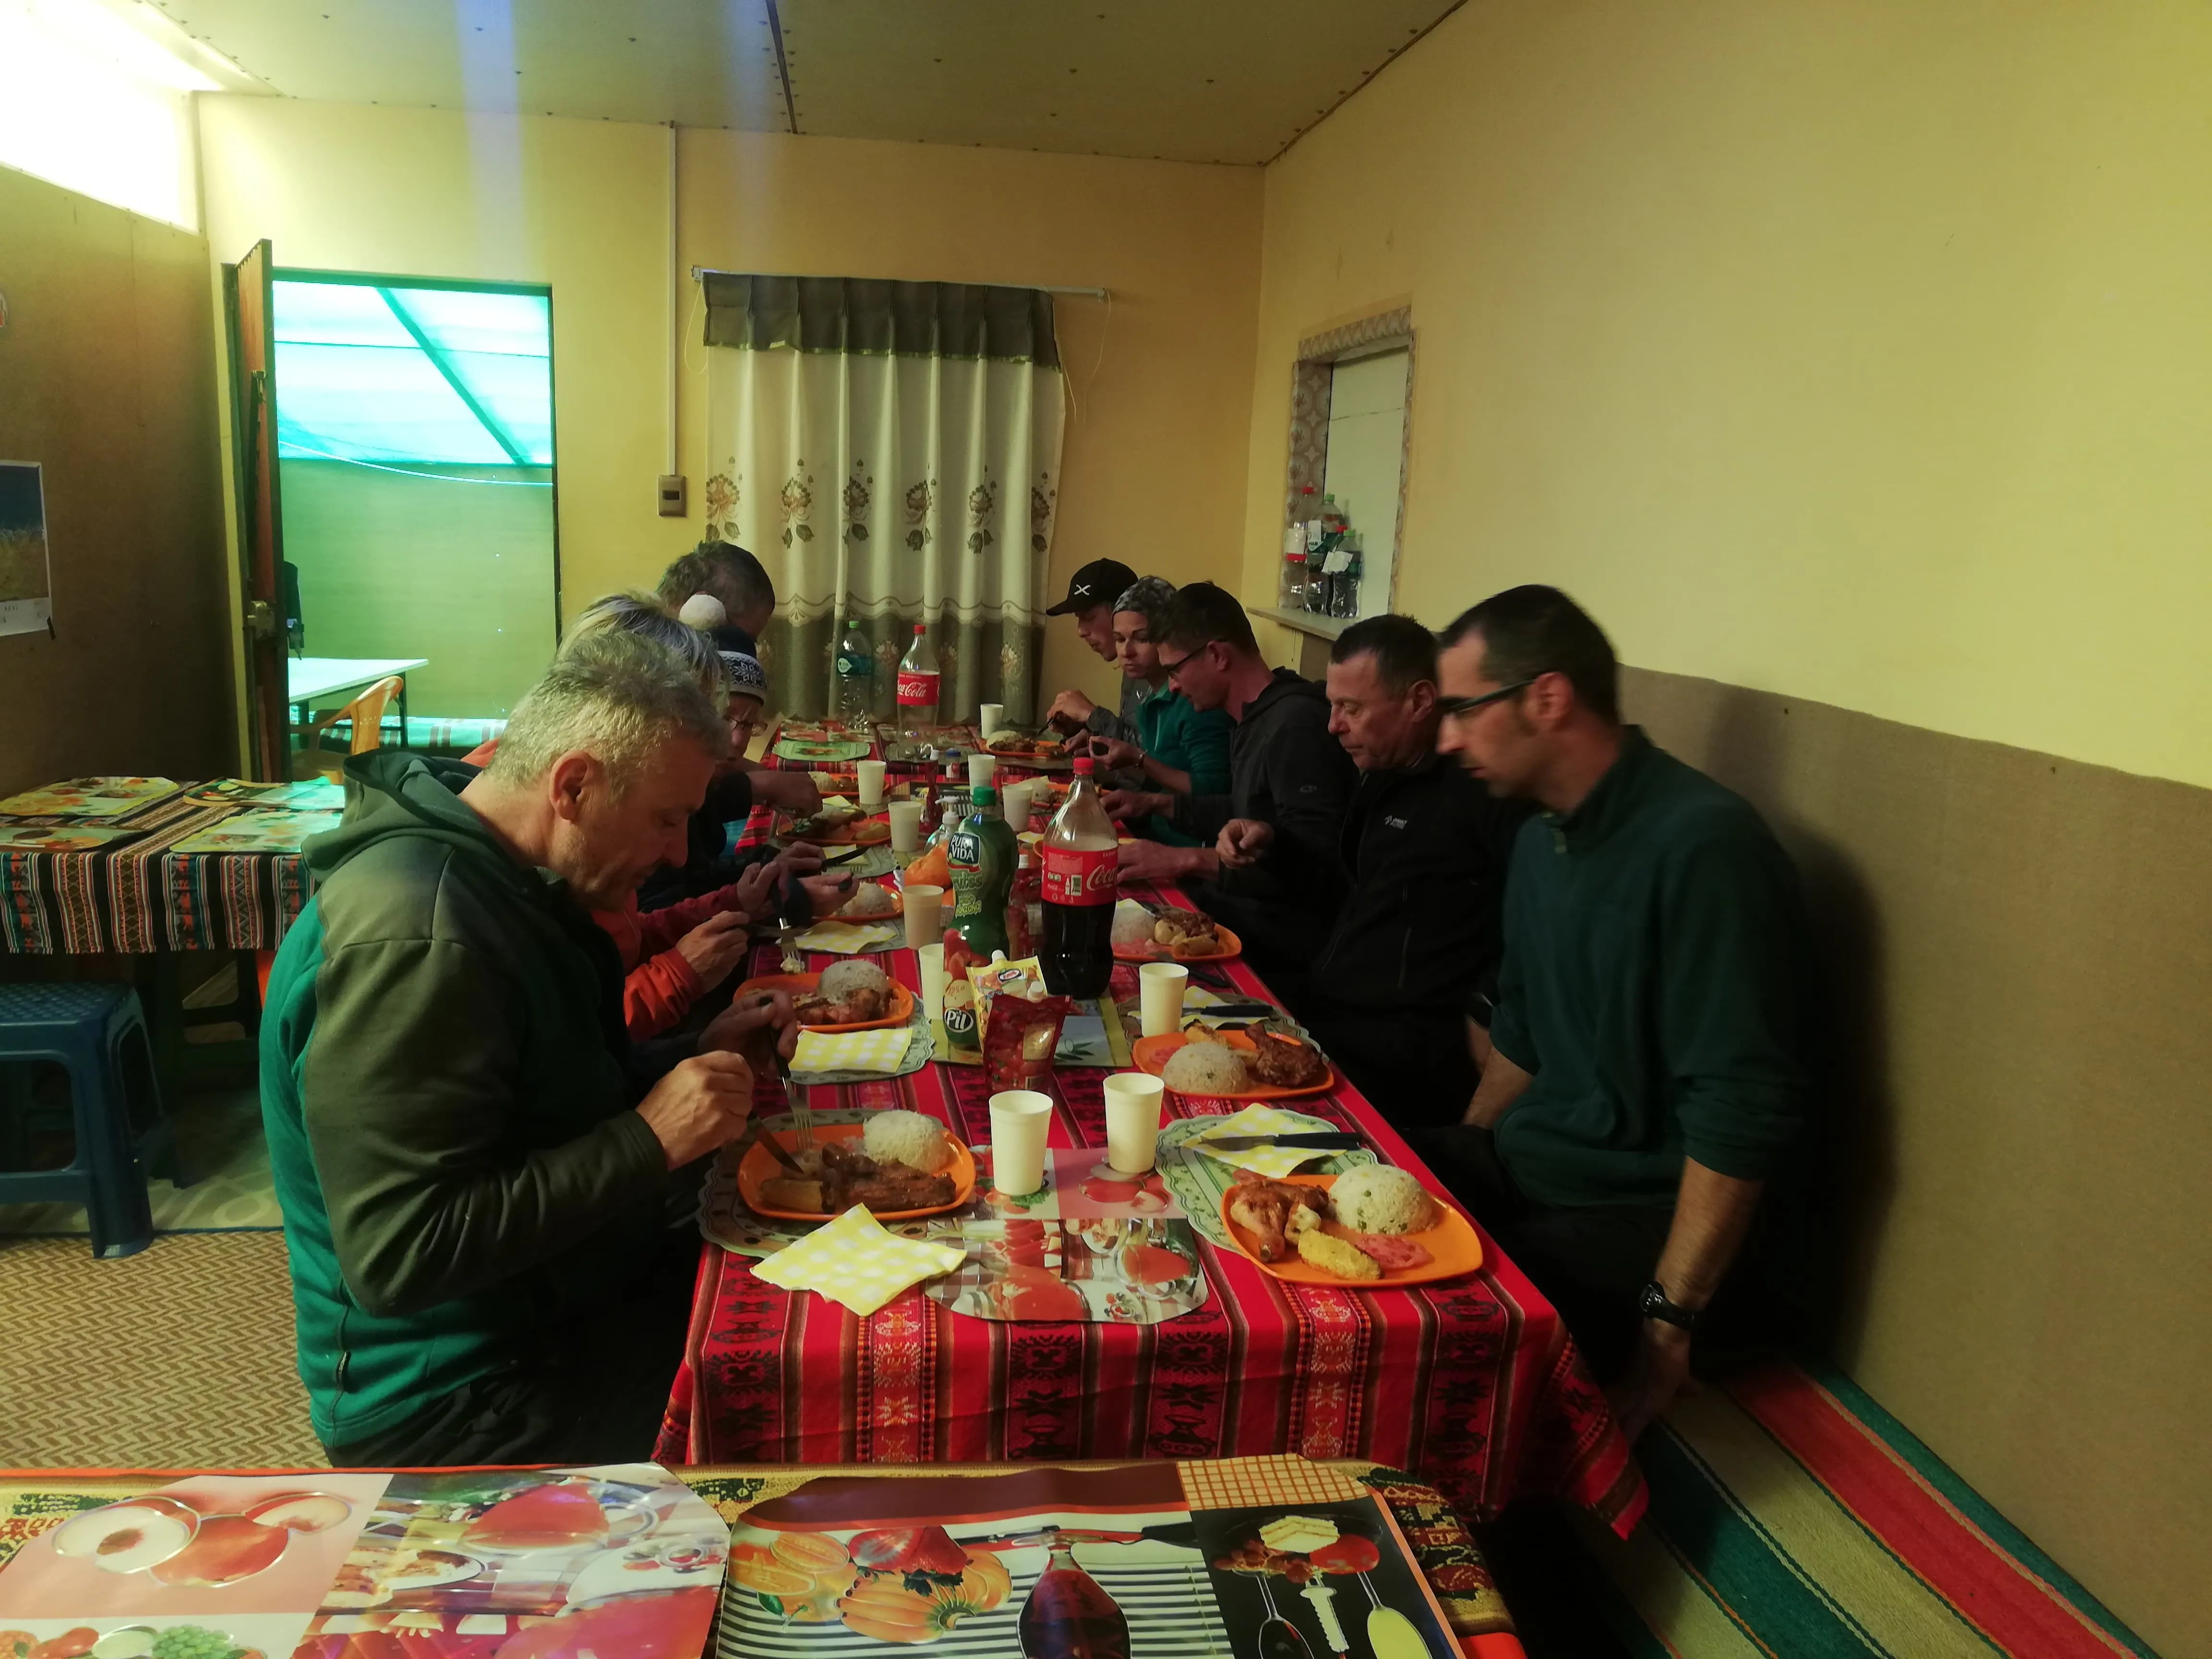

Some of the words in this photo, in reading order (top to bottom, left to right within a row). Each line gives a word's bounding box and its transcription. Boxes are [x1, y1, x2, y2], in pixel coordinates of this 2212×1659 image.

[950, 835, 974, 850] PURA
[952, 845, 974, 862] VIDA
[947, 1010, 967, 1029] Pil
